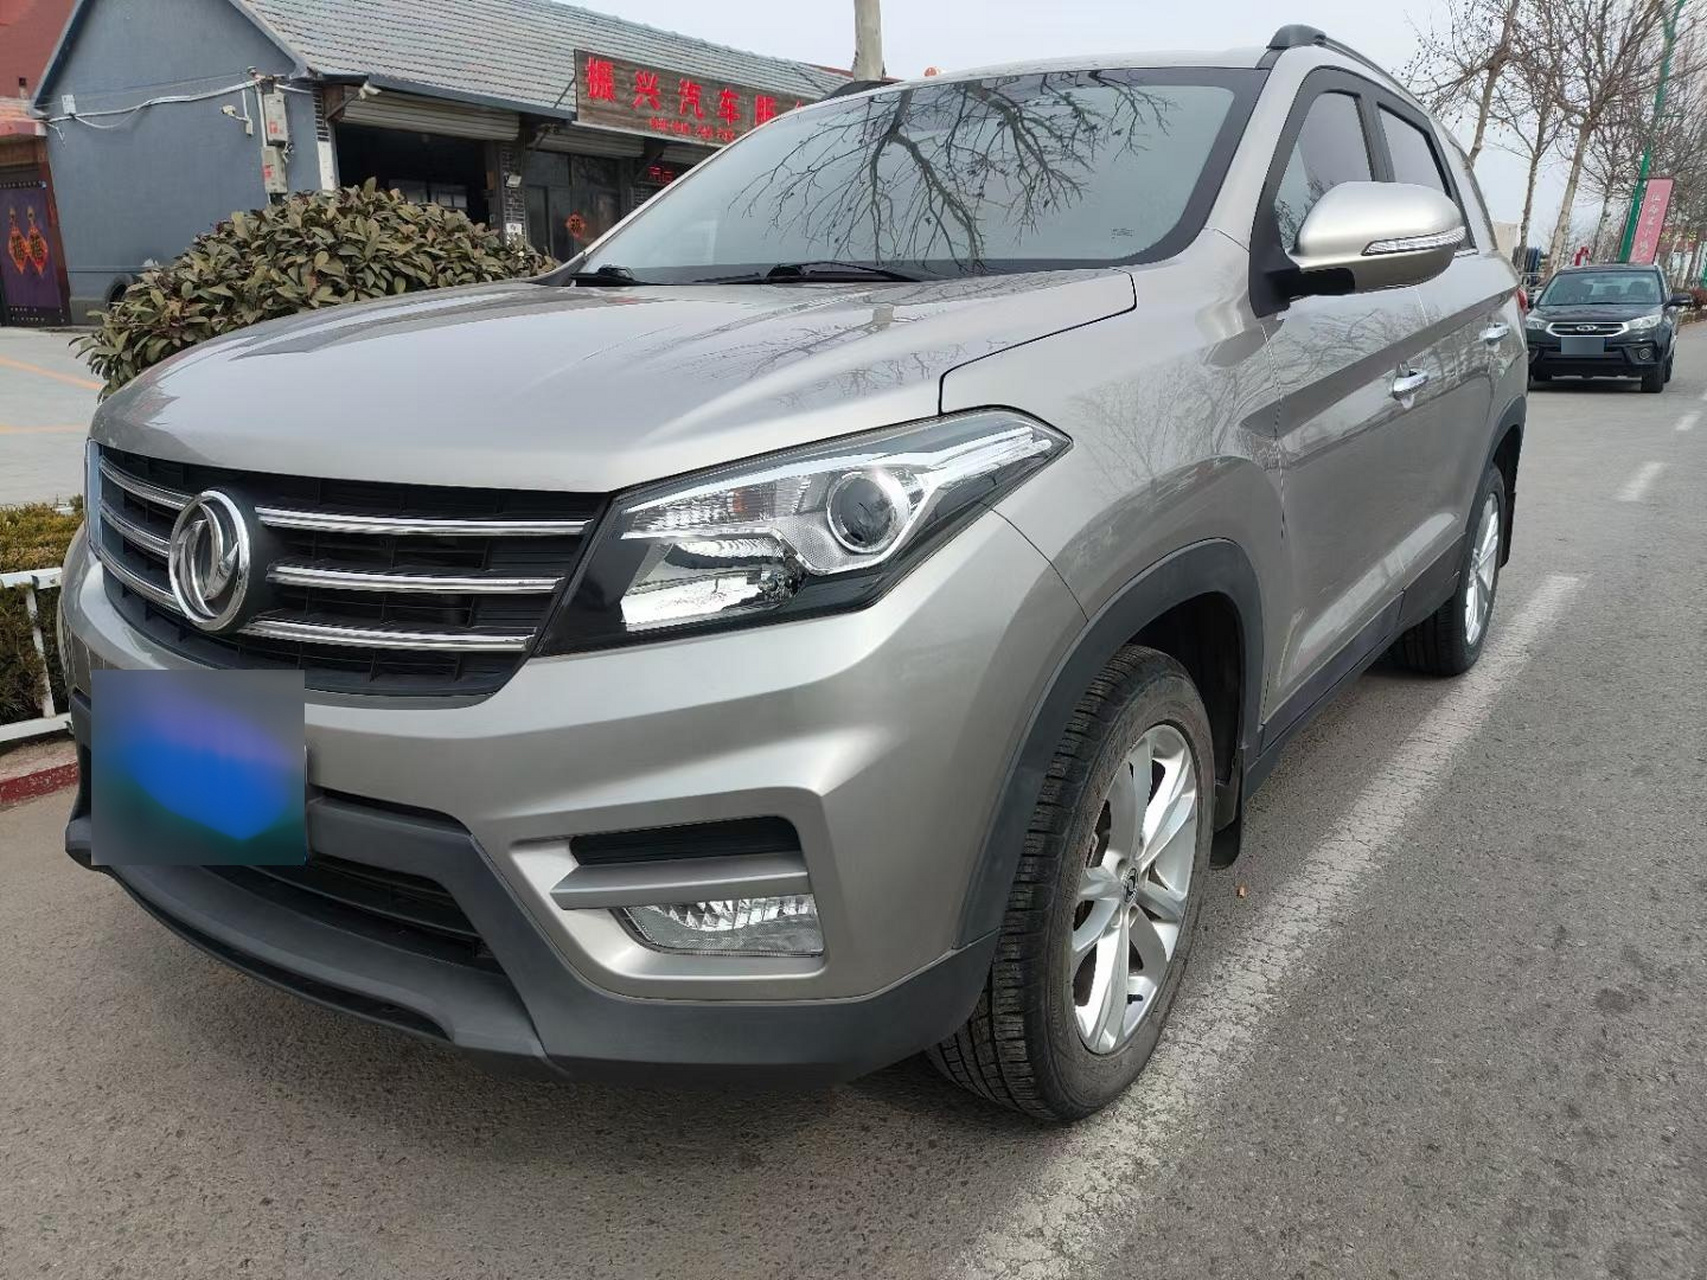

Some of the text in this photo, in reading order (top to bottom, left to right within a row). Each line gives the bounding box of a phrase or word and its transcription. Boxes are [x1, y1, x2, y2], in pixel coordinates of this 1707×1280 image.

[585, 56, 803, 126] 振兴汽车服
